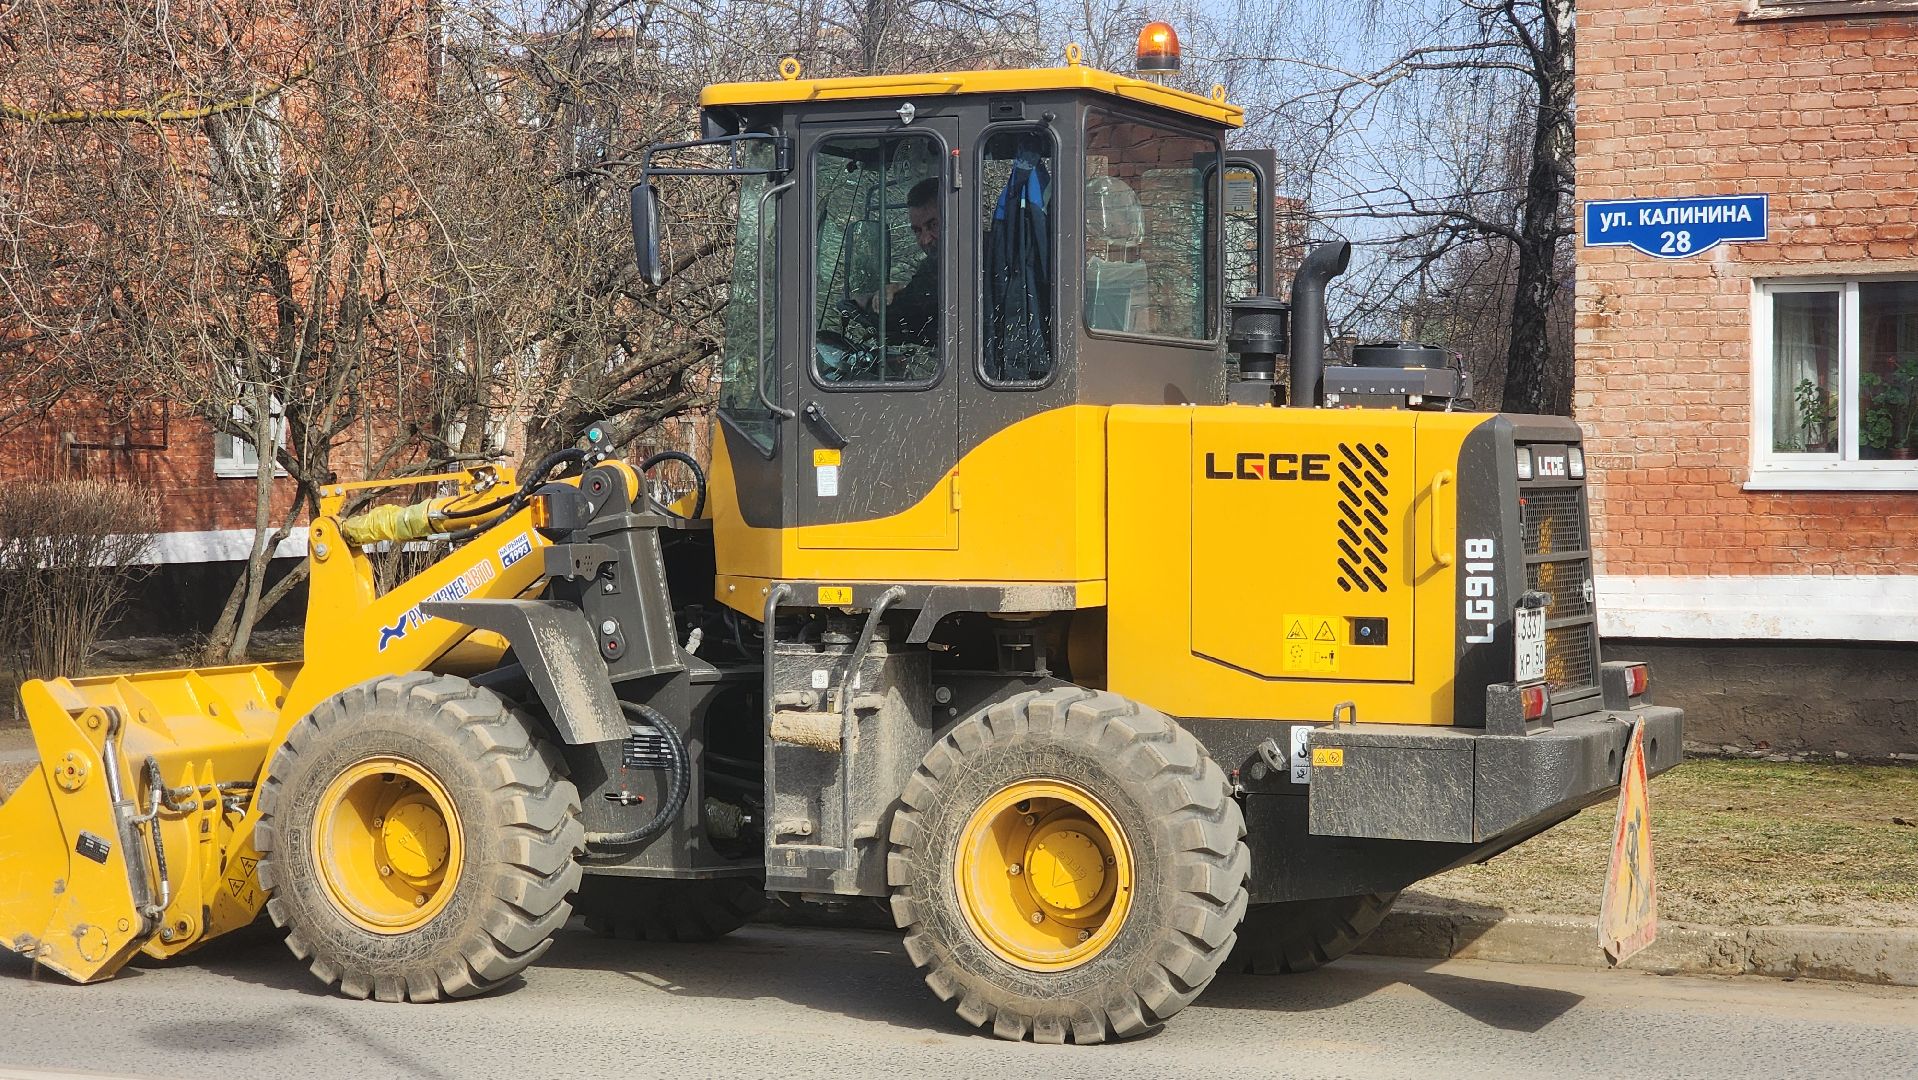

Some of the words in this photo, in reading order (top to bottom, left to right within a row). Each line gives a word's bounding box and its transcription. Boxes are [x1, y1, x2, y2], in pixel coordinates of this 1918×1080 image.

[1600, 212, 1633, 233] ул.
[1639, 204, 1752, 225] КАЛИНИНА
[1660, 231, 1691, 253] 28
[510, 543, 529, 563] 1993
[1465, 538, 1494, 644] LG918
[1520, 610, 1542, 640] 3337
[1535, 644, 1544, 665] 50
